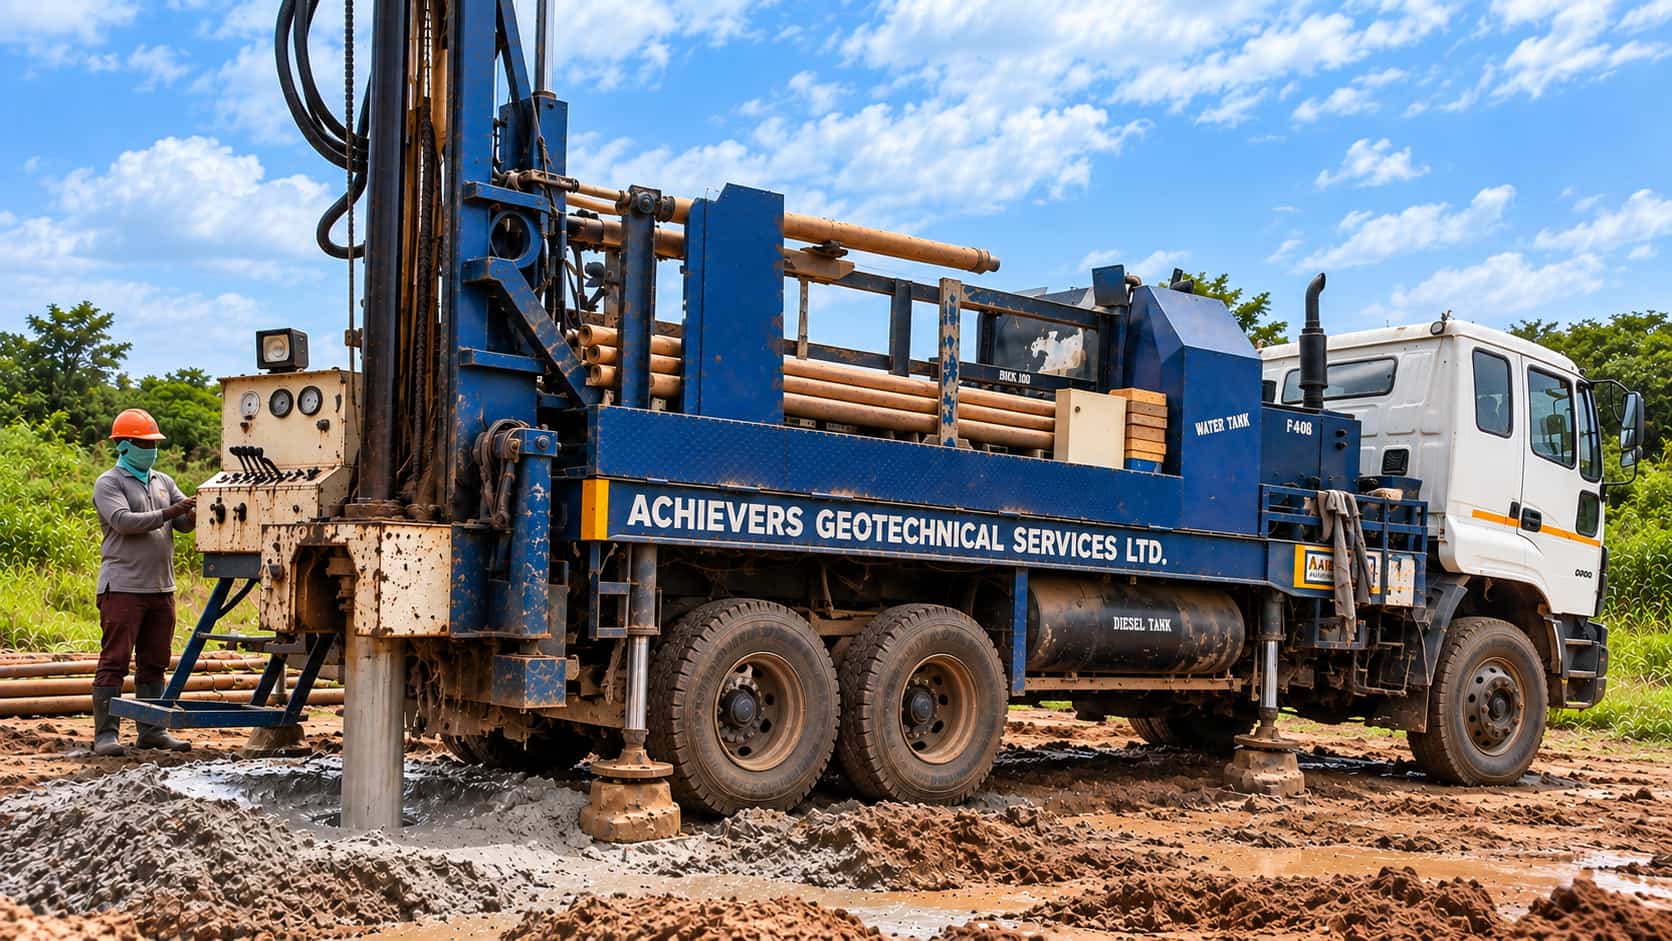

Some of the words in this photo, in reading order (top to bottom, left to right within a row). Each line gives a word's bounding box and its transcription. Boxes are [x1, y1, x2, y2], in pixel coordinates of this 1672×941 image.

[1195, 418, 1225, 436] WATER
[1226, 413, 1251, 430] TANK
[627, 494, 804, 537] ACHIEVERS
[816, 509, 1005, 551] GEOTECHNICAL
[1013, 526, 1118, 561] SERVICES
[1126, 537, 1168, 566] LTD.
[1113, 616, 1146, 631] DIESEL
[1147, 618, 1172, 632] TANK
